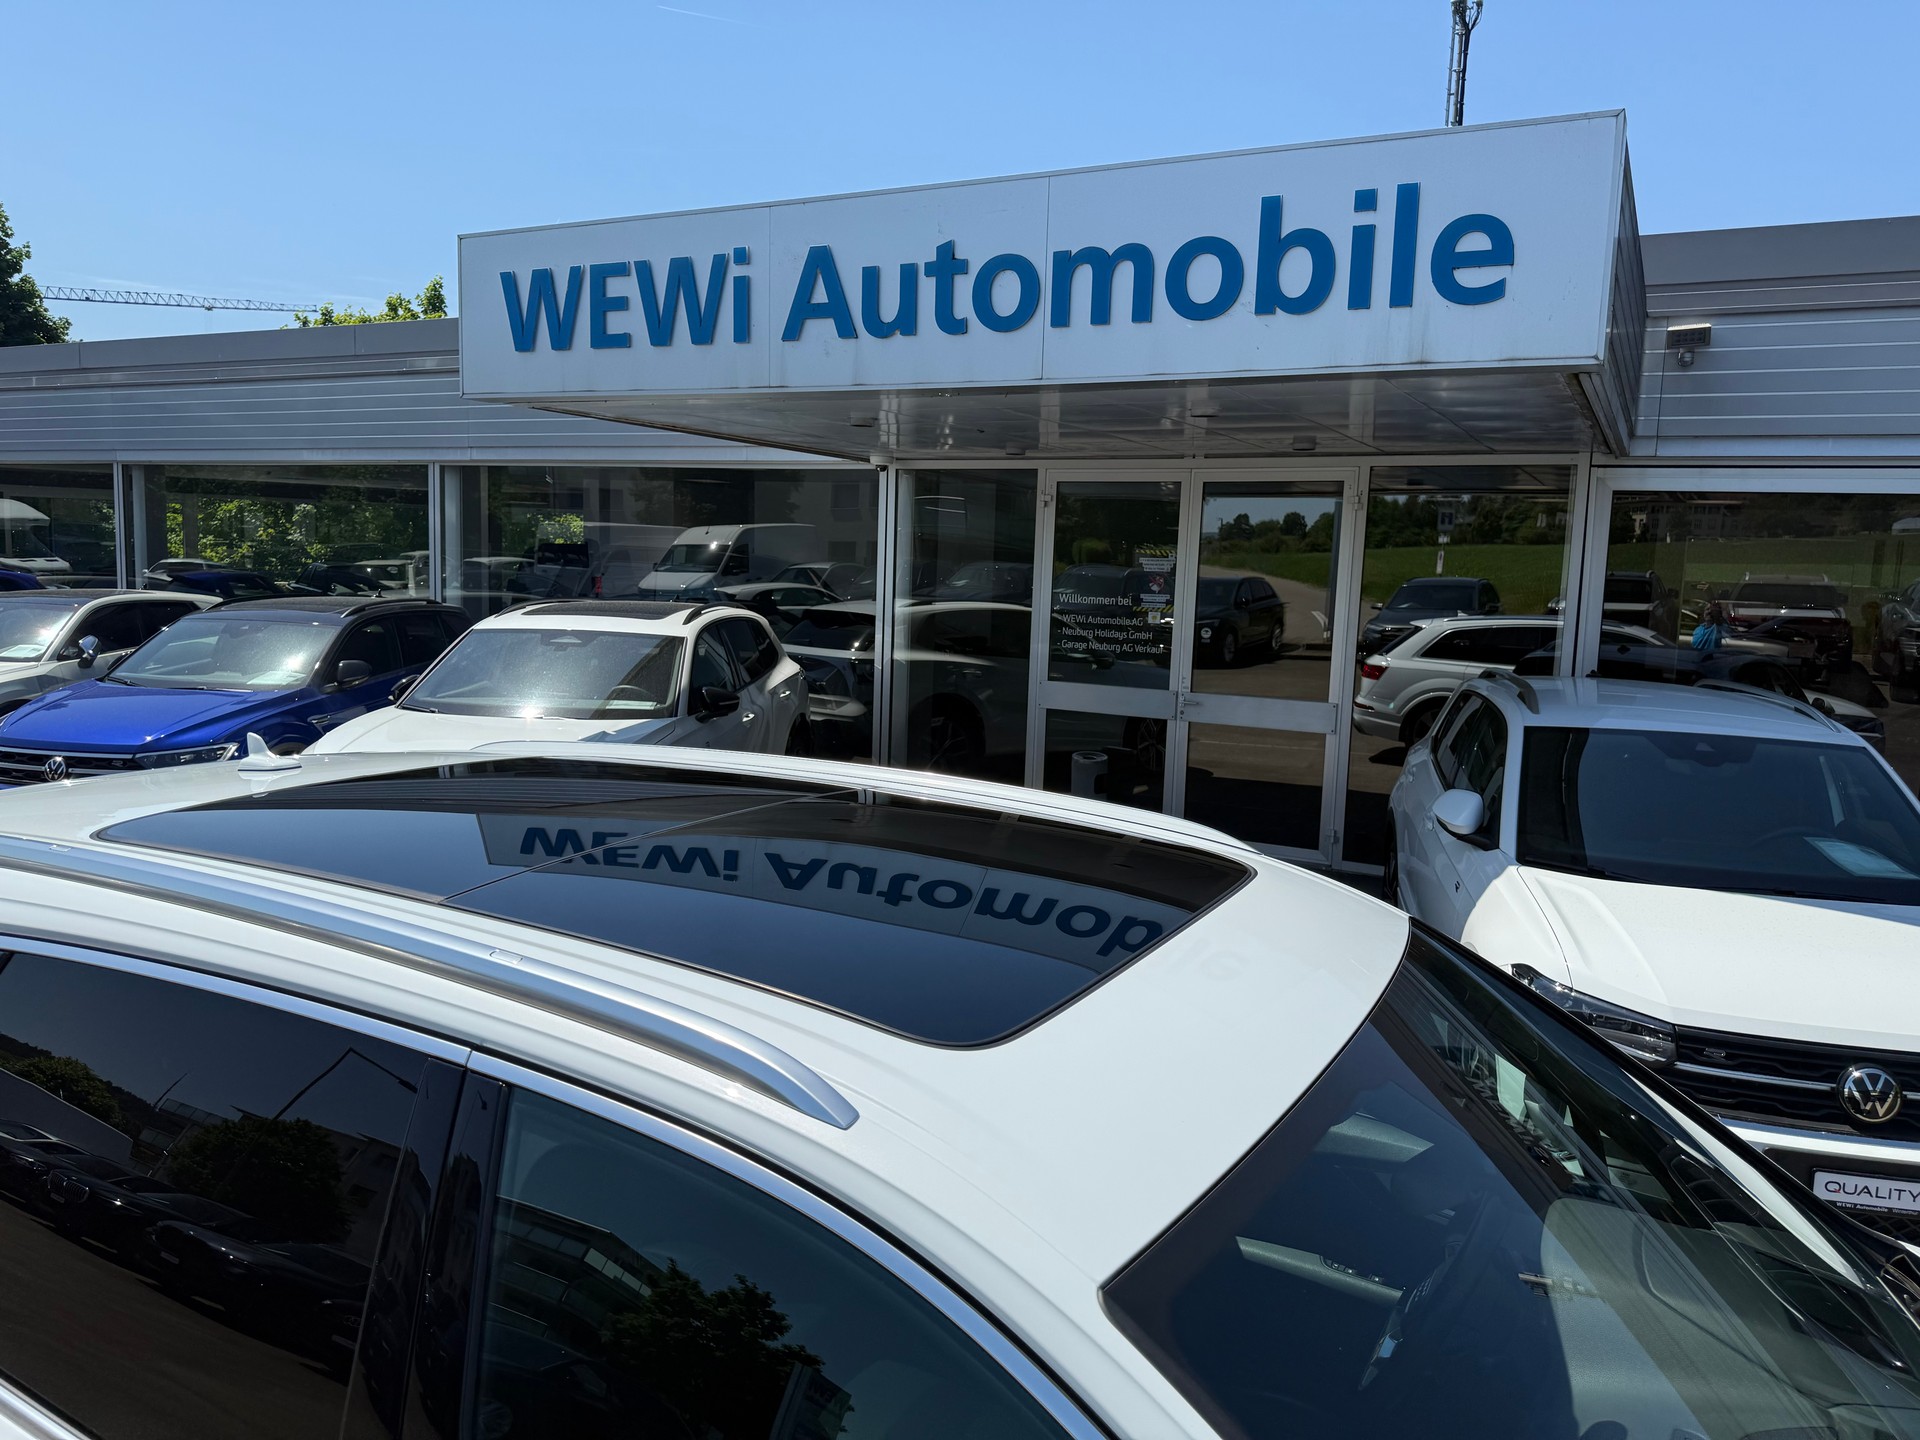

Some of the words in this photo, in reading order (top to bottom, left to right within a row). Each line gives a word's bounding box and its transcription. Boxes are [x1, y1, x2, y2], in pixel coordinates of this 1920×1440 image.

[500, 246, 749, 352] WEWi
[781, 182, 1514, 342] Automobile
[1059, 594, 1116, 605] Willkommen
[1118, 595, 1132, 606] bei
[1062, 614, 1086, 623] WEWi
[1087, 616, 1131, 626] Automobile
[1131, 617, 1144, 627] AG
[1062, 627, 1094, 639] Neuburg
[1094, 629, 1128, 641] Holidays
[1129, 631, 1153, 640] GmbH
[1061, 640, 1088, 651] Garage
[1089, 641, 1121, 653] Neuburg
[1122, 643, 1133, 652] AG
[1134, 644, 1163, 654] Verkauf
[1824, 1180, 1920, 1203] QUALITY
